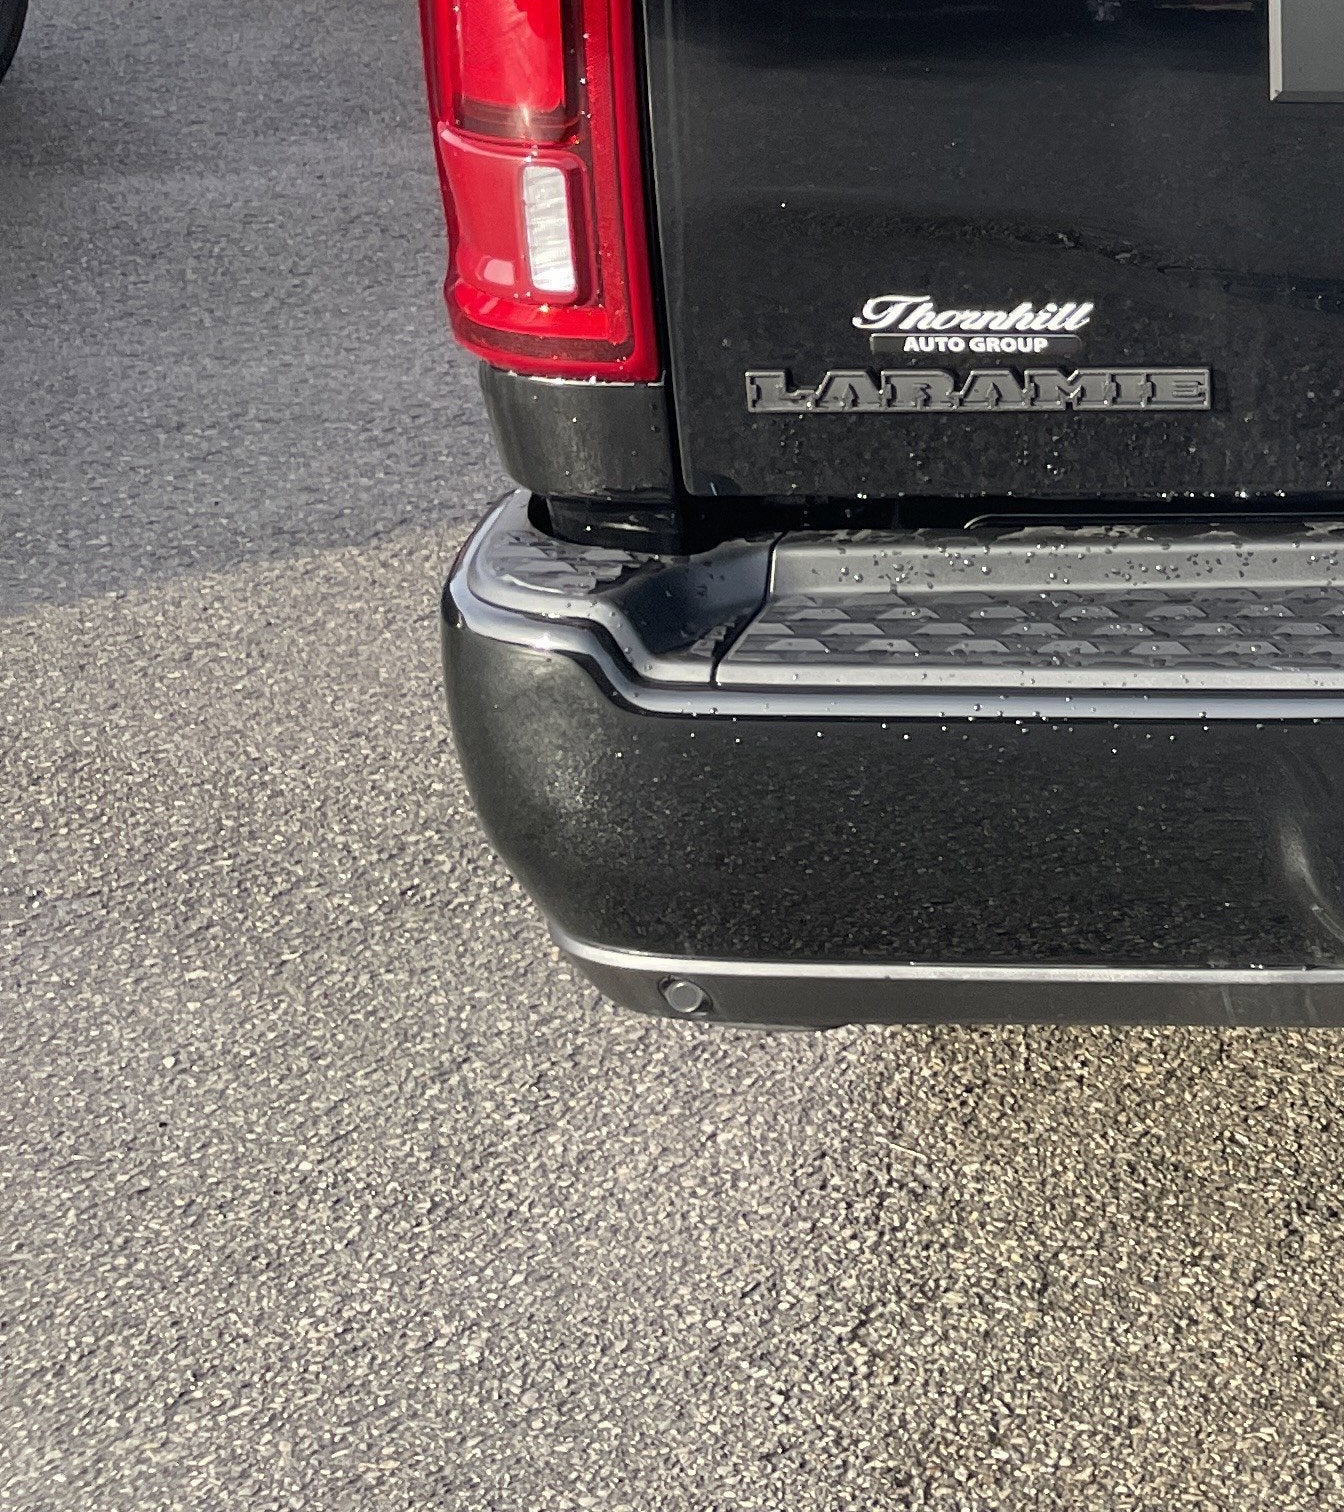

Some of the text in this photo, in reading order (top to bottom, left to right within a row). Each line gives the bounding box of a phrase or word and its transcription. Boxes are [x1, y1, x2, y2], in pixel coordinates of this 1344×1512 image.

[852, 295, 1095, 331] Thornhill
[903, 336, 1049, 353] AUTO GROUP
[745, 368, 1212, 413] LARAMIE
